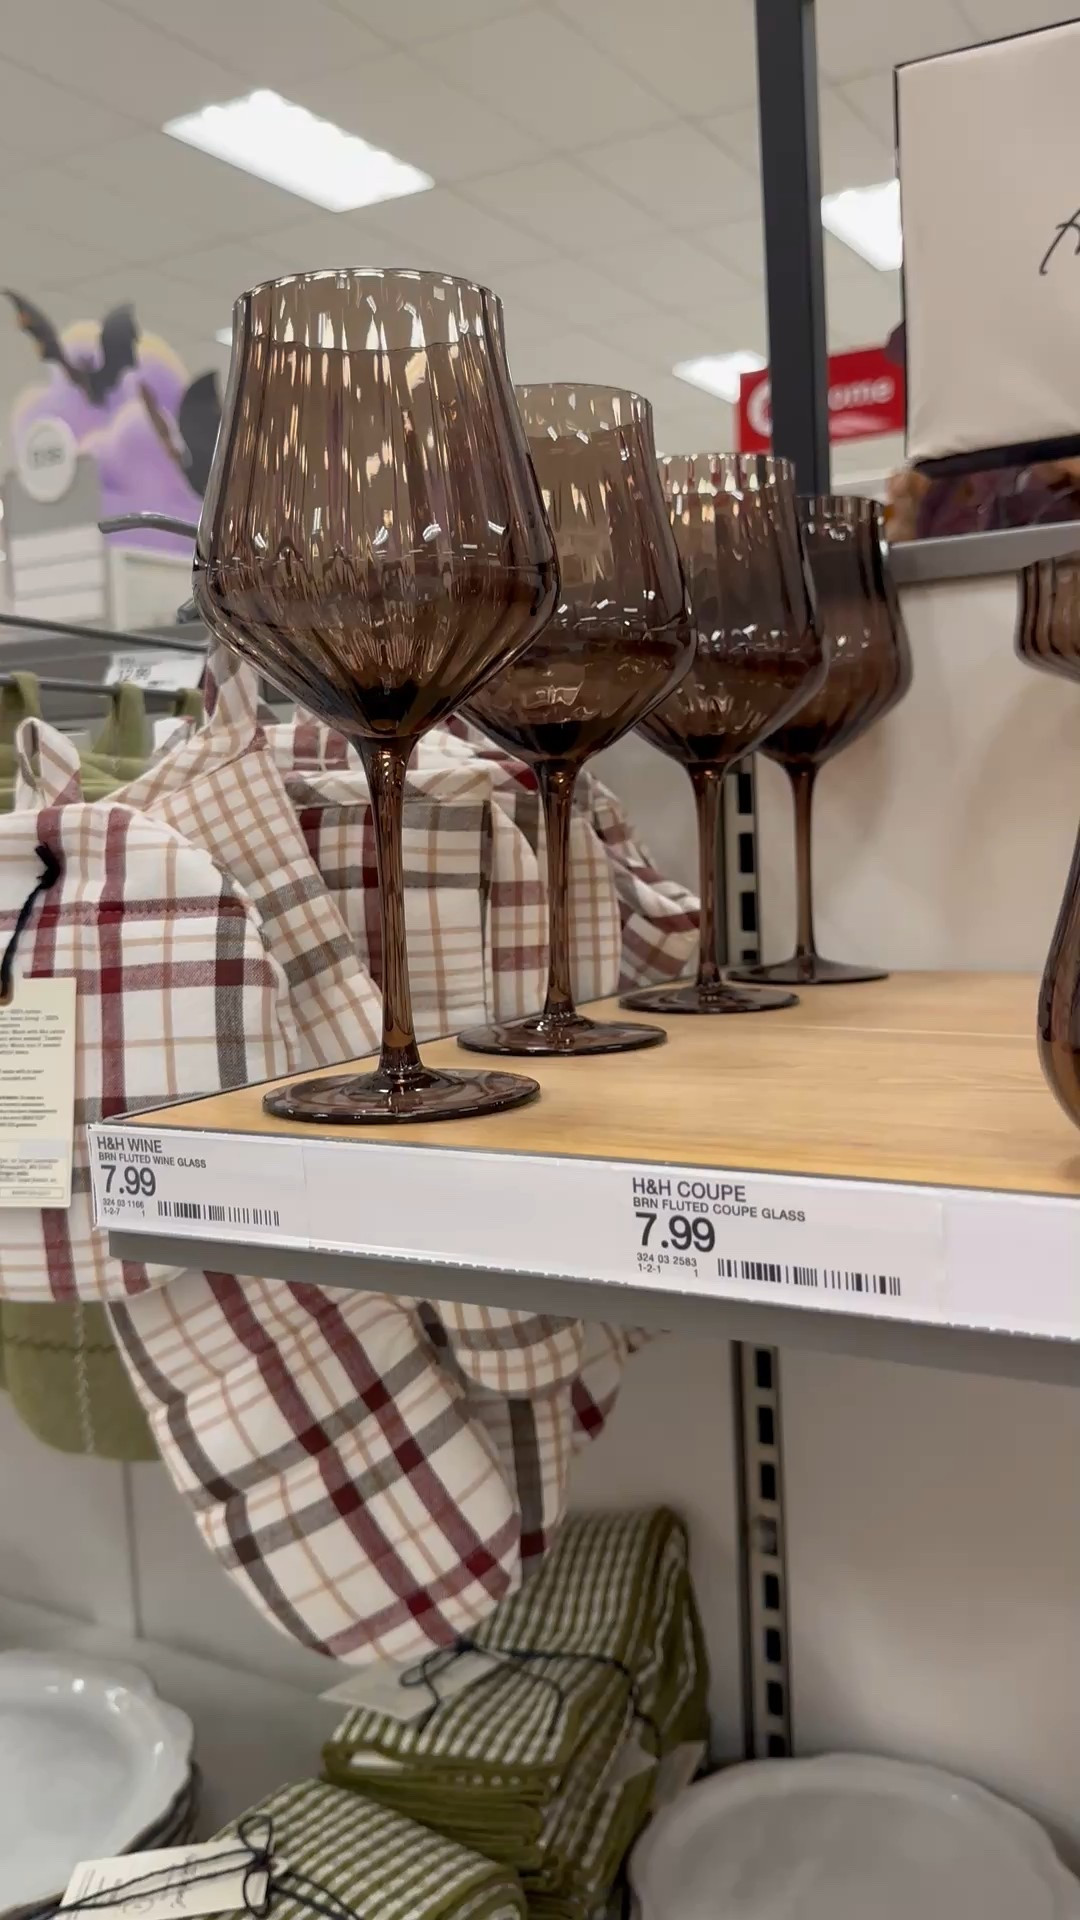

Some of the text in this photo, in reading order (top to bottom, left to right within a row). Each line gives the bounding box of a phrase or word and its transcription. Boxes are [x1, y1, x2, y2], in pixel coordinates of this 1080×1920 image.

[827, 377, 894, 411] ome
[96, 1136, 162, 1153] H&H WINE
[98, 1152, 206, 1168] BRN FLUTED WINE GLASS
[100, 1164, 156, 1197] 7.99
[632, 1177, 747, 1203] H&H COUPE
[102, 1198, 115, 1206] 324
[632, 1196, 806, 1222] BRN FLUTED COUPE GLASS
[103, 1207, 120, 1215] 1-2-7
[635, 1211, 716, 1253] 7.99
[636, 1253, 697, 1267] 324 03 2583
[637, 1263, 662, 1274] 1-2-1
